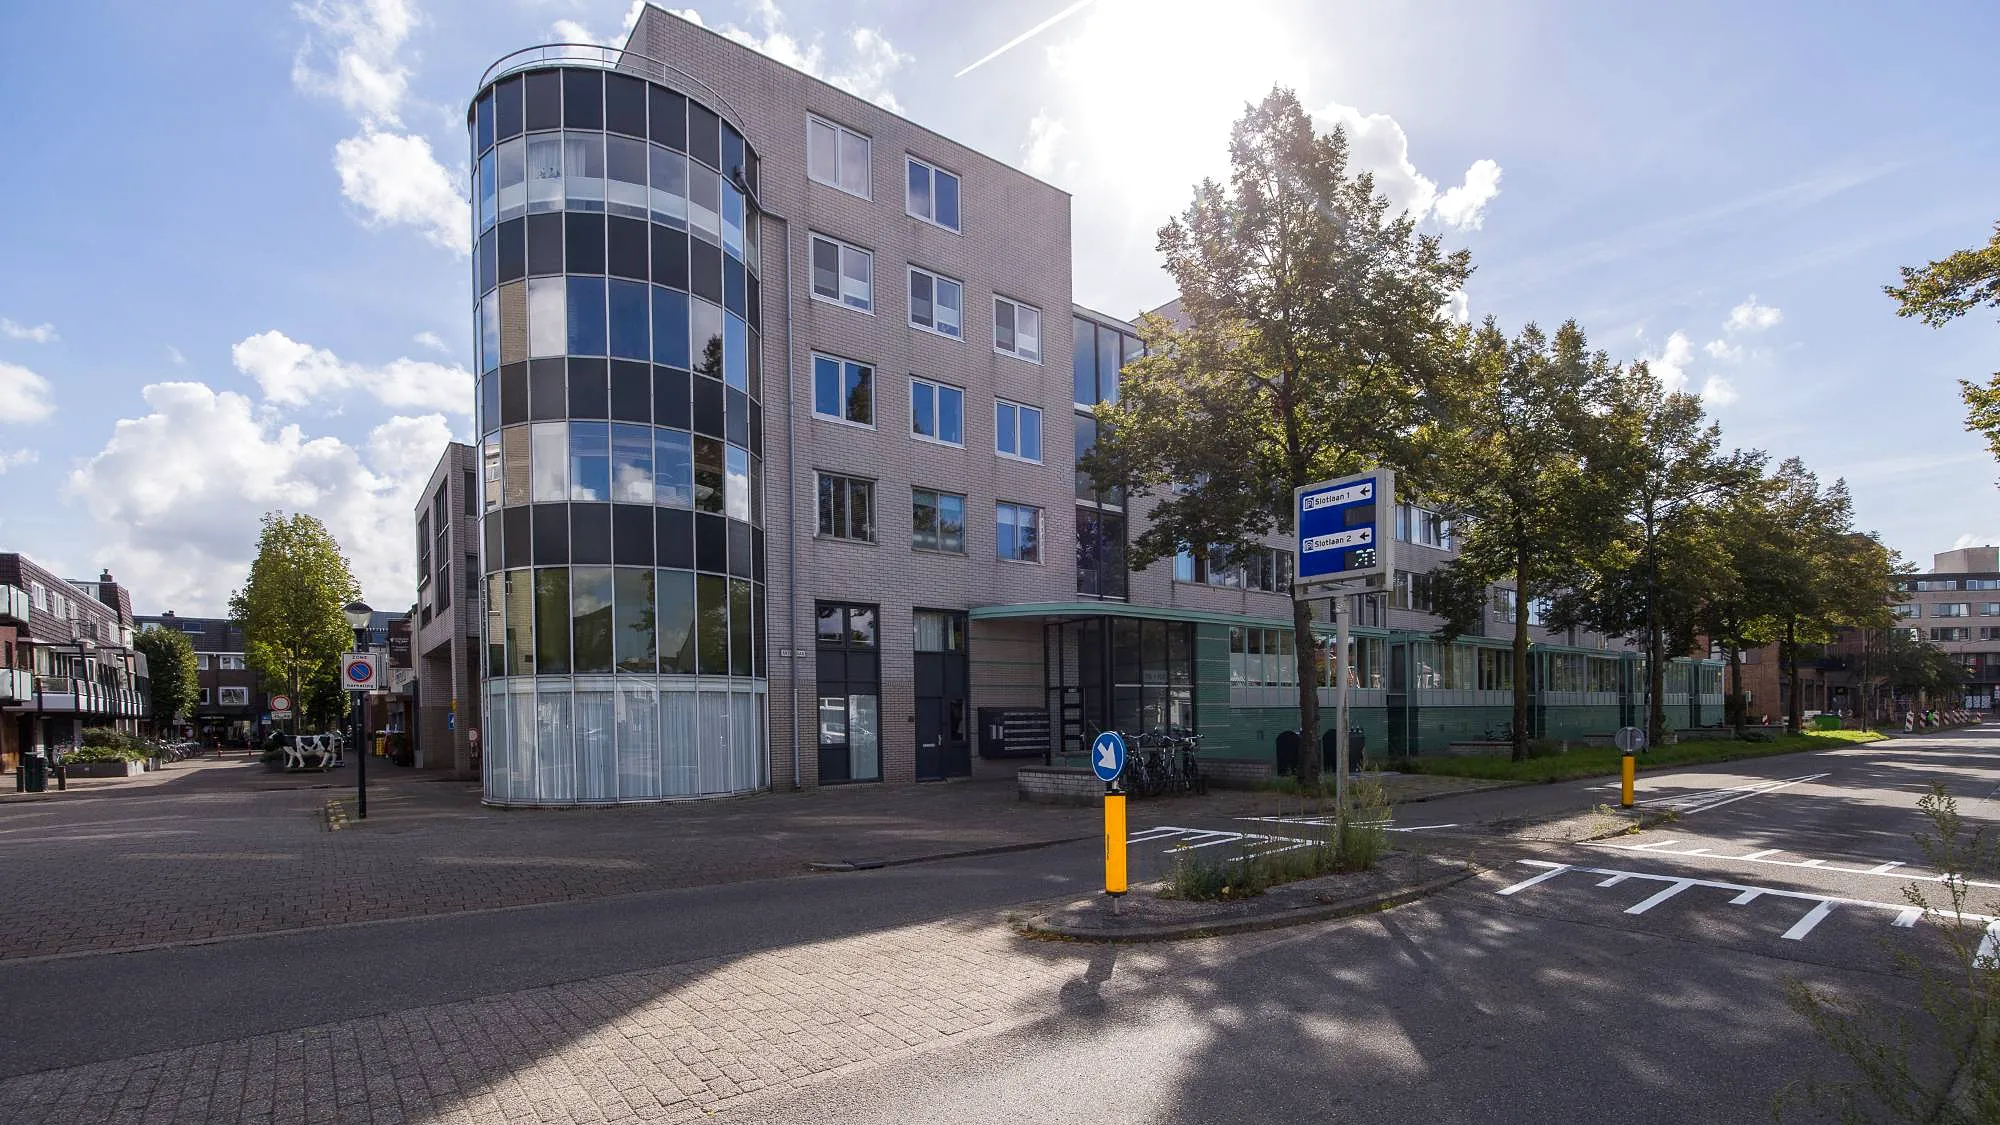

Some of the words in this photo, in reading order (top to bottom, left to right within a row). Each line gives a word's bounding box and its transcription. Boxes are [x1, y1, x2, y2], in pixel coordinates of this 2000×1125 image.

[1315, 494, 1344, 505] Slotlaan
[1314, 537, 1343, 547] Slotlaan
[1346, 535, 1352, 543] 2
